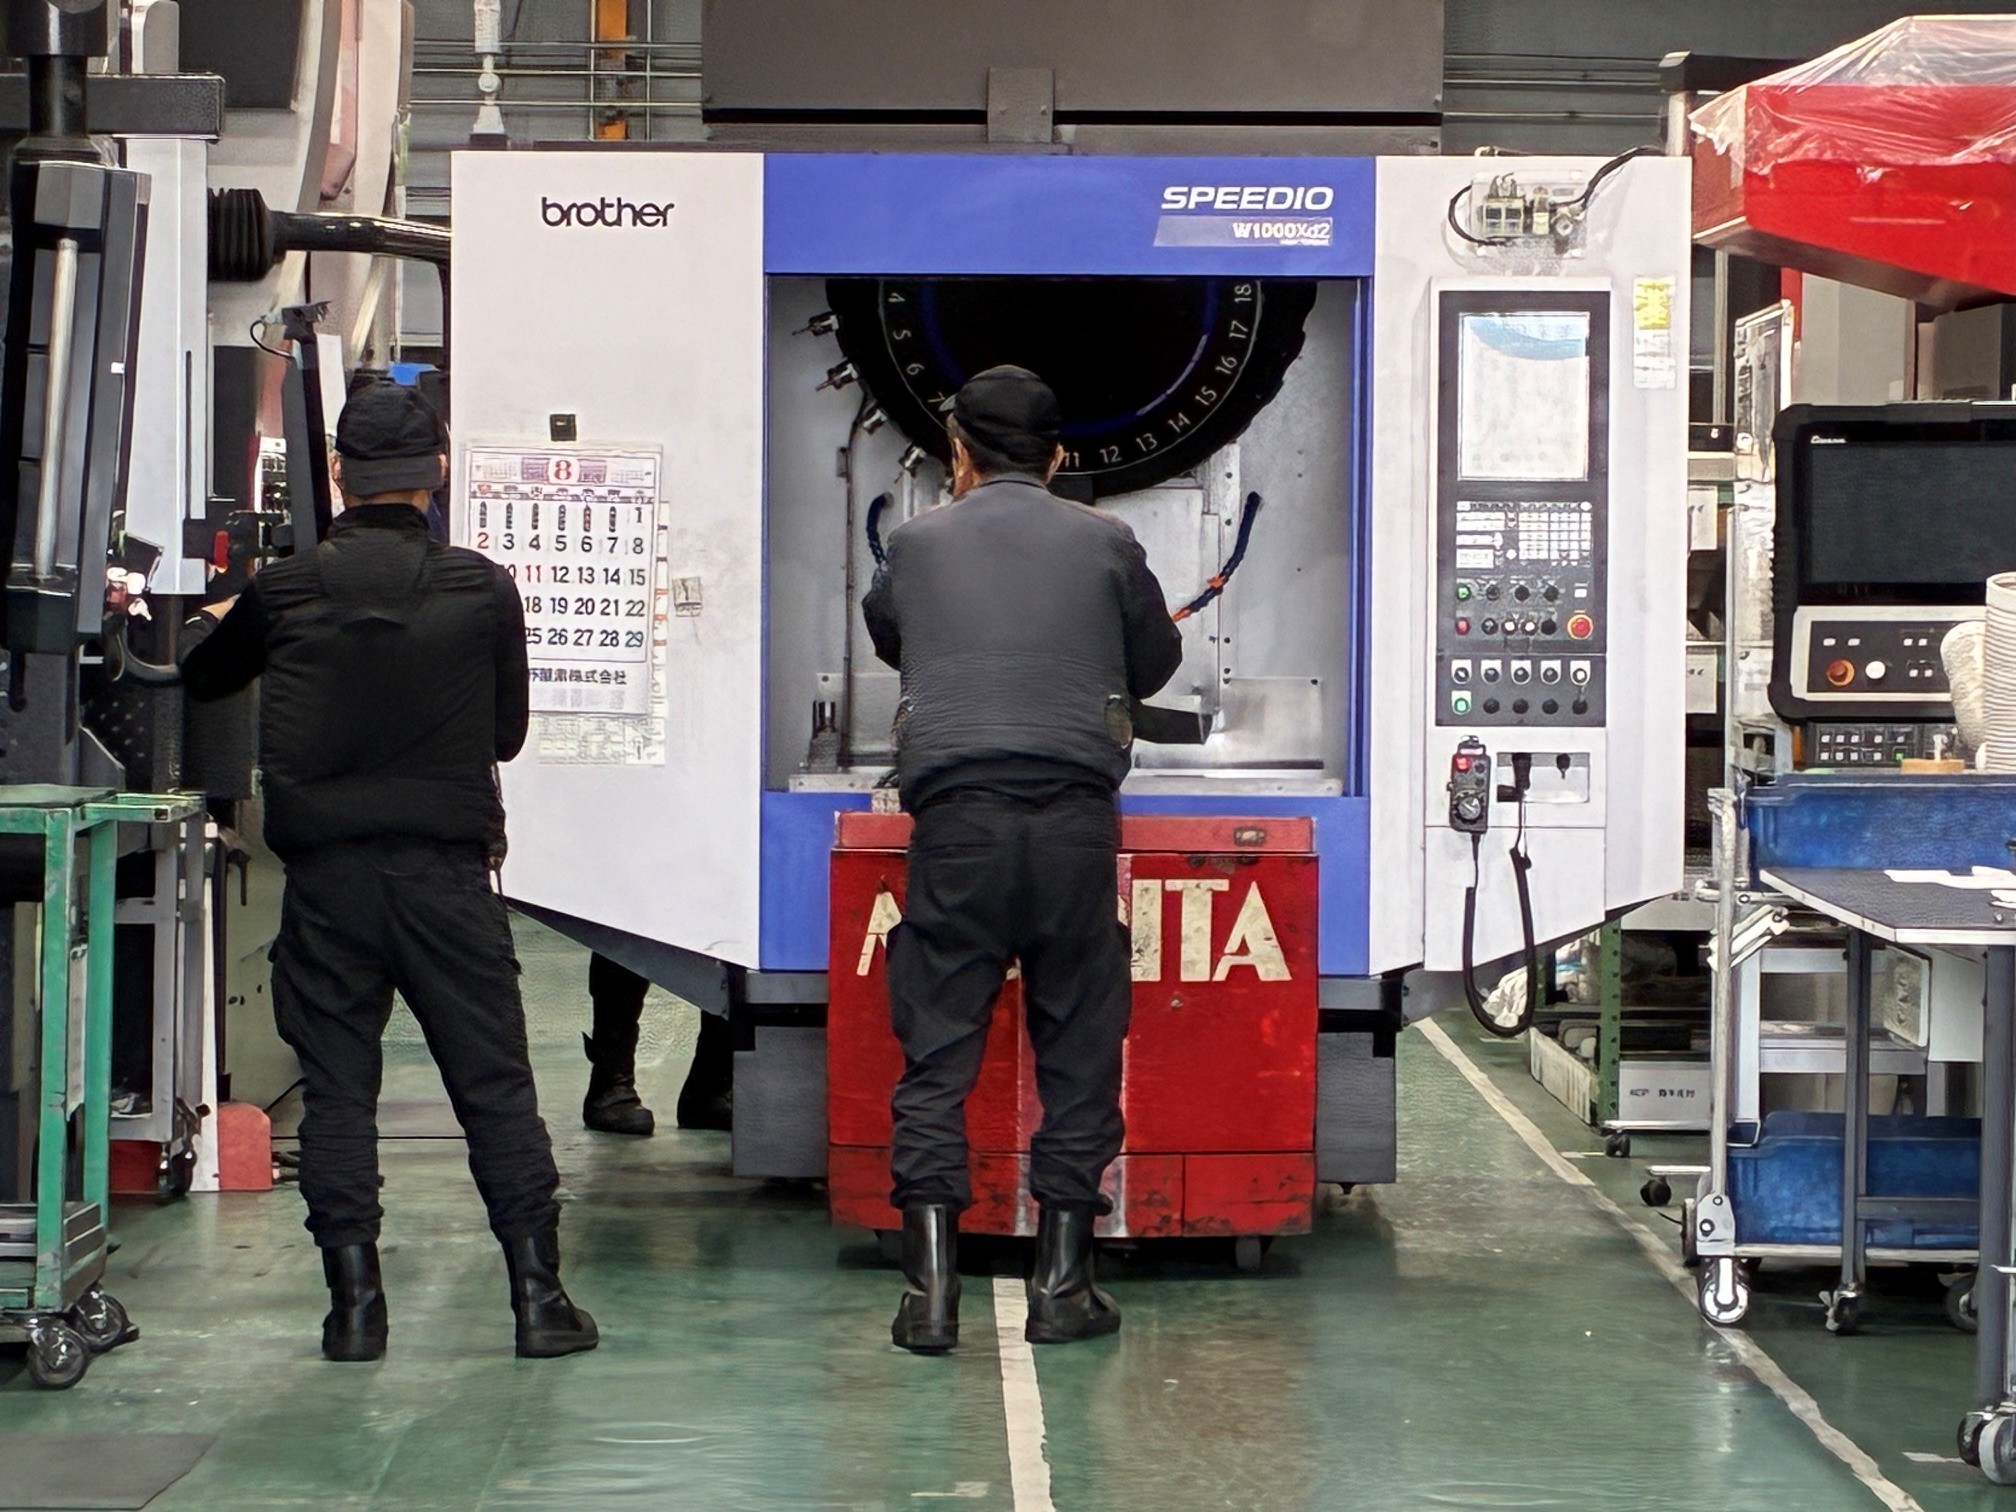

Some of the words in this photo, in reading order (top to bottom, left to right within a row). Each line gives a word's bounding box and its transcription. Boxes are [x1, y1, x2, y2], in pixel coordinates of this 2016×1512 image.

[1161, 186, 1334, 211] SPEEDIO
[541, 197, 675, 227] brother
[1235, 284, 1252, 303] 18
[893, 329, 912, 340] 5
[1229, 320, 1249, 339] 17
[906, 363, 925, 375] 6
[1215, 355, 1238, 375] 16
[1195, 385, 1218, 406] 15
[1167, 412, 1191, 433] 14
[1136, 433, 1158, 452] 13
[1064, 452, 1080, 468] 11
[1099, 446, 1123, 464] 12
[554, 460, 572, 480] 8
[635, 506, 642, 524] 1
[477, 532, 489, 549] 2
[503, 533, 515, 550] 3
[529, 534, 541, 551] 4
[555, 535, 567, 552] 5
[581, 535, 593, 553] 6
[607, 537, 618, 553] 7
[633, 537, 644, 554] 8
[525, 565, 541, 583] 11
[551, 566, 569, 583] 12
[578, 566, 595, 584] 13
[602, 567, 621, 585] 14
[629, 569, 646, 586] 15
[525, 596, 542, 613] 18
[550, 597, 568, 614] 19
[574, 597, 595, 616] 20
[600, 598, 619, 616] 21
[625, 600, 645, 617] 22
[547, 628, 568, 646] 26
[573, 629, 594, 646] 27
[599, 630, 620, 647] 28
[625, 630, 644, 648] 29
